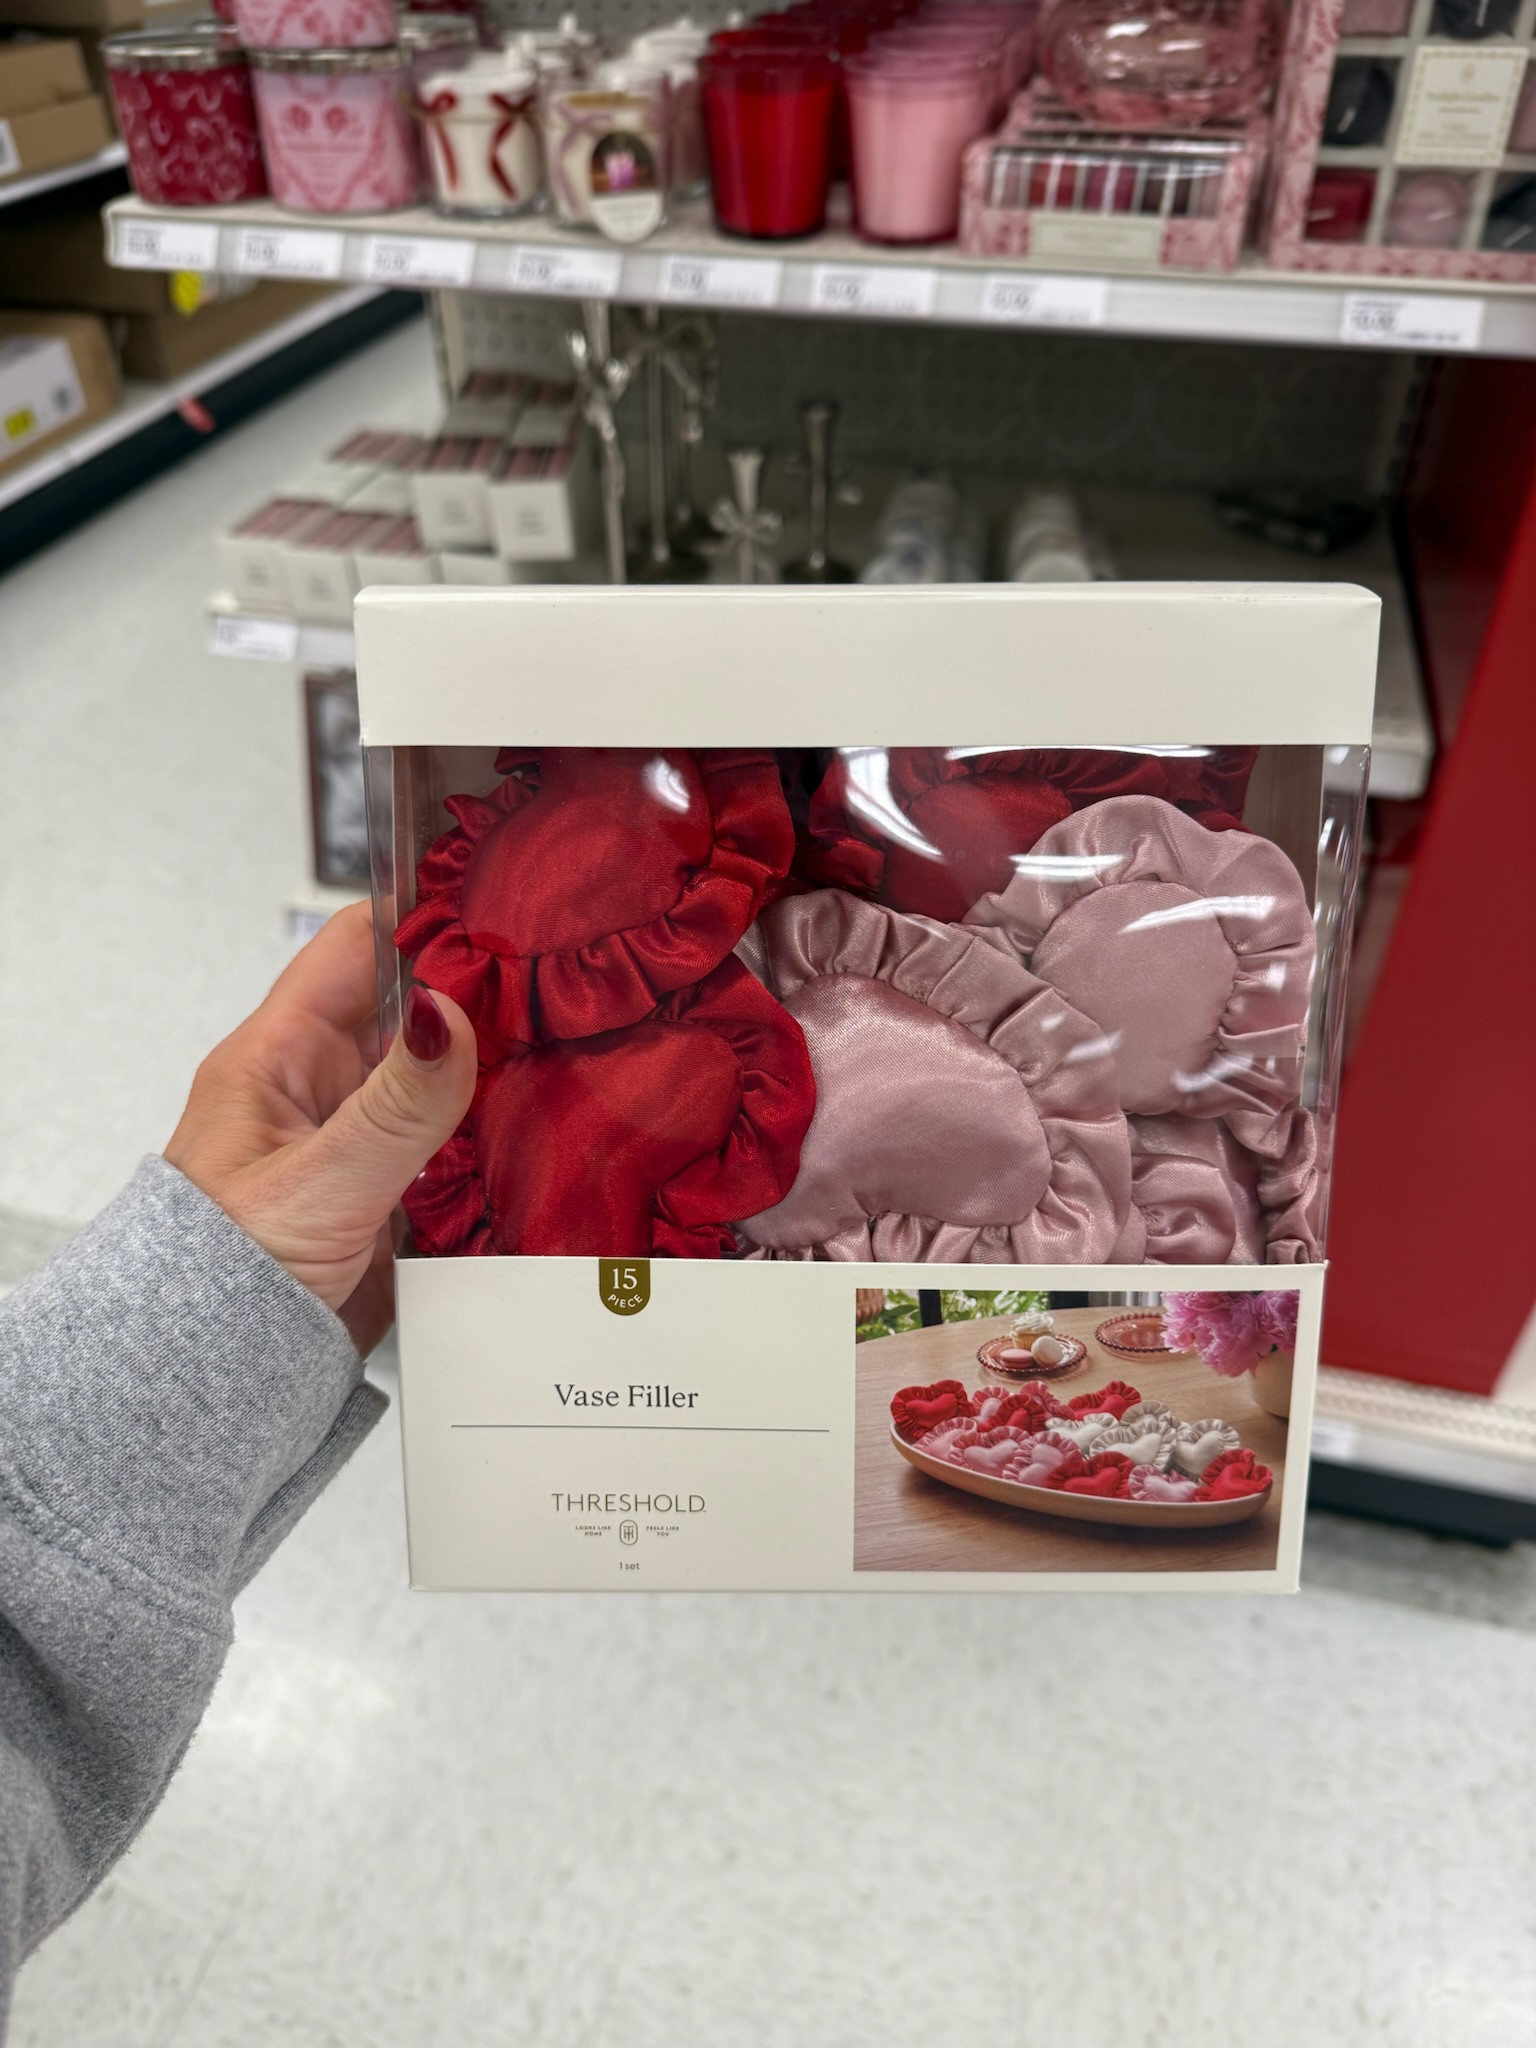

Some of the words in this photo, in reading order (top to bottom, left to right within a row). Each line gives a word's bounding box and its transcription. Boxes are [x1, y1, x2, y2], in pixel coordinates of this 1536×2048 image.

[612, 1267, 638, 1290] 15
[607, 1293, 643, 1309] PIECE
[554, 1384, 620, 1407] Vase
[628, 1384, 699, 1408] Filler
[551, 1493, 706, 1513] THRESHOLD
[619, 1562, 623, 1570] 1
[624, 1562, 640, 1570] set
